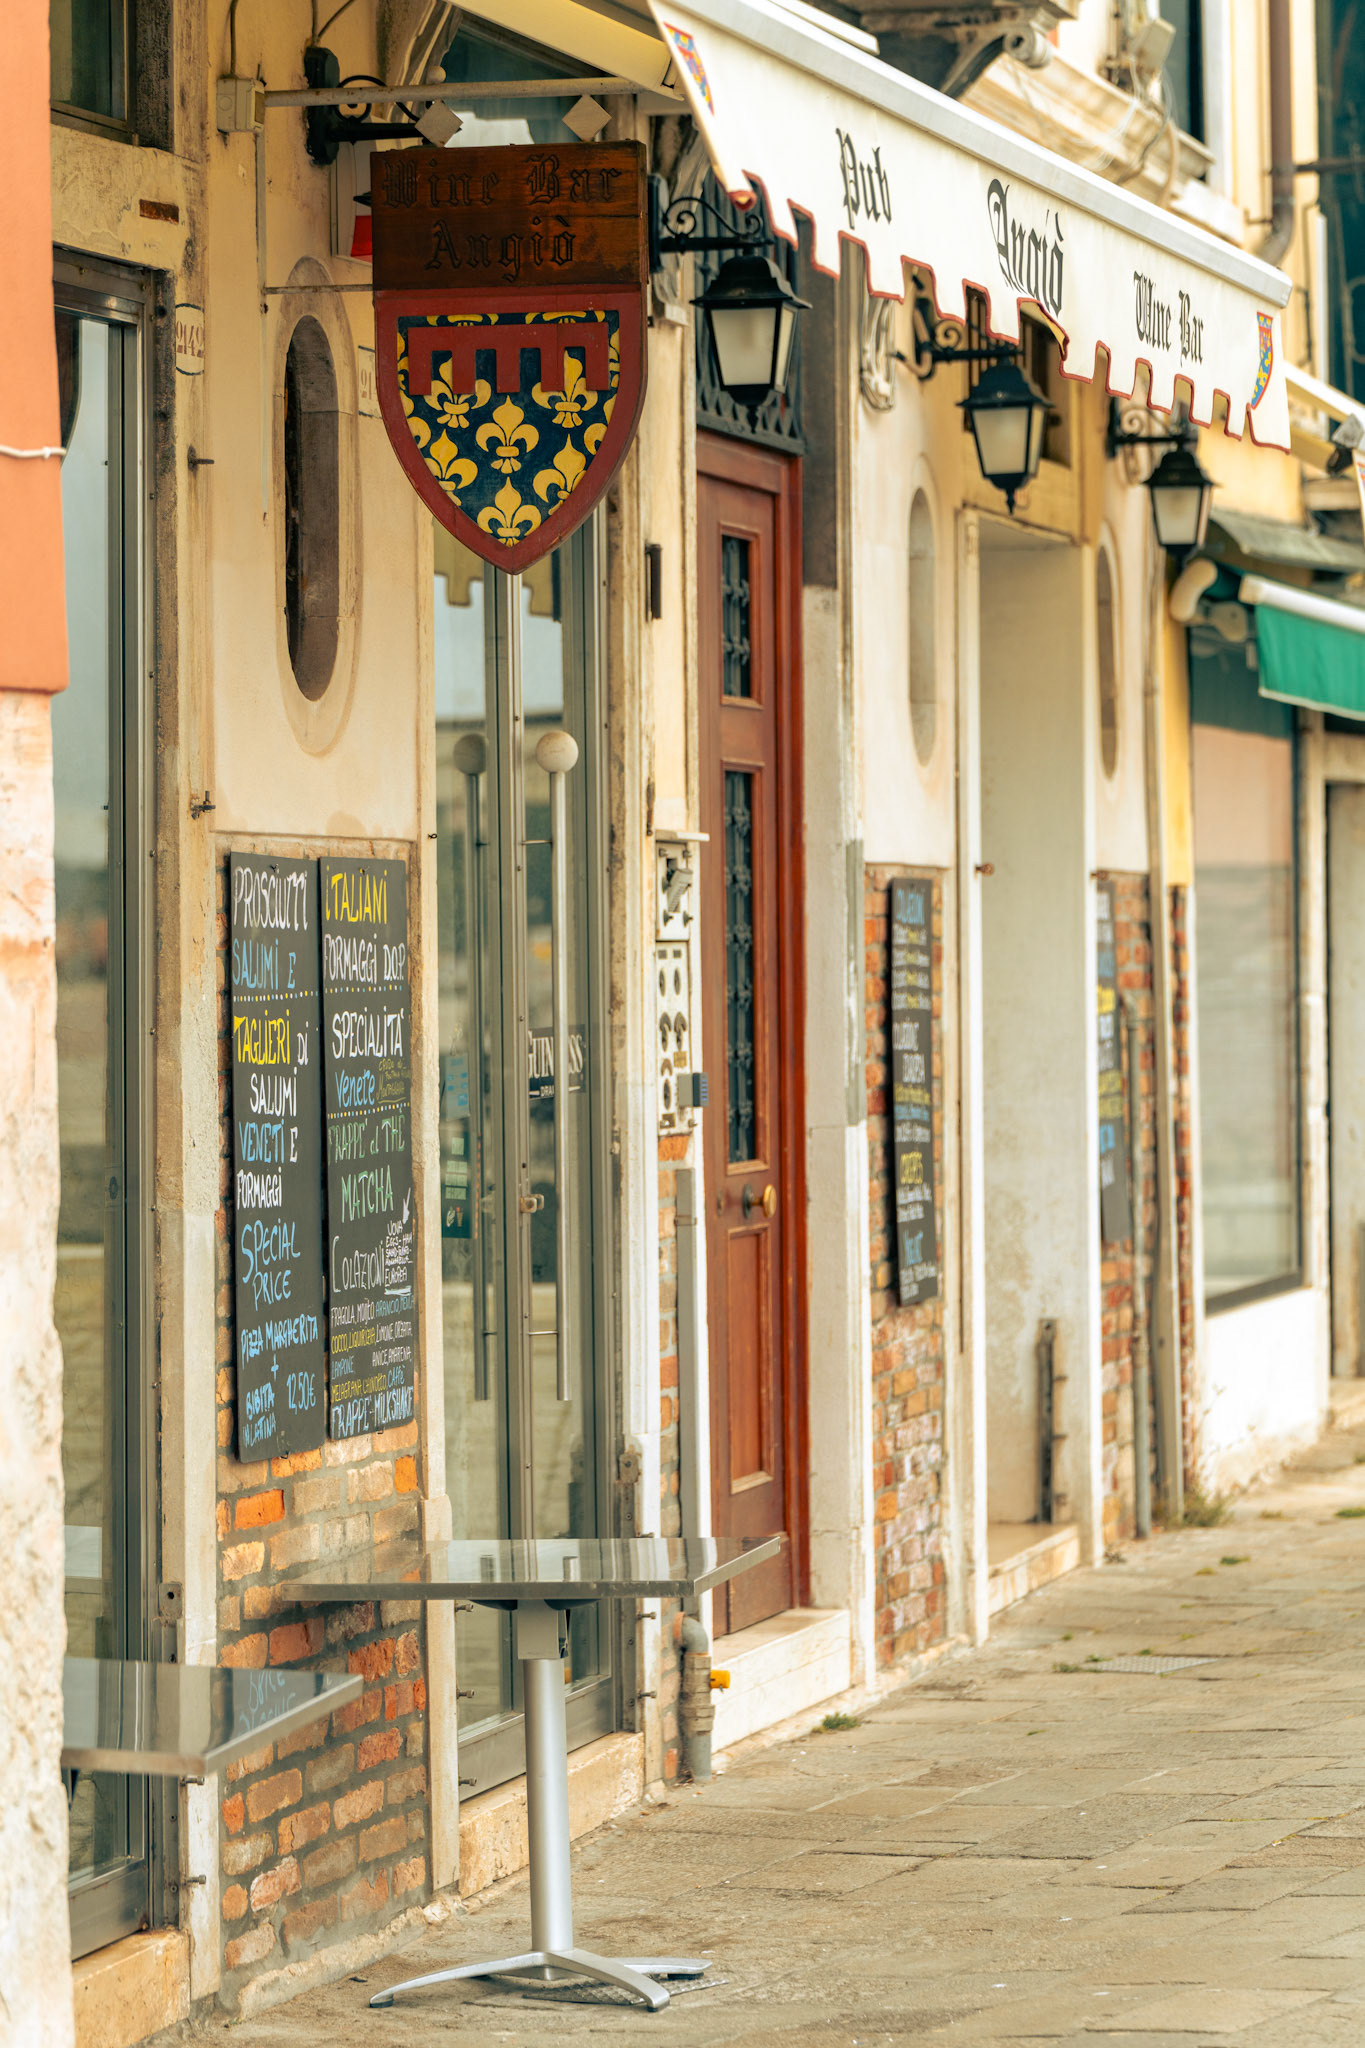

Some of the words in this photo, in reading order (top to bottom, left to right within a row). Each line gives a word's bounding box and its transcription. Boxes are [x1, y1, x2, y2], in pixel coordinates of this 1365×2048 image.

[382, 157, 500, 208] Wine
[525, 153, 622, 206] Bar
[836, 128, 892, 230] Pub
[425, 215, 576, 283] Angiò
[1133, 270, 1172, 351] Wine
[1179, 290, 1204, 367] Bar
[287, 952, 297, 989] E
[290, 1127, 298, 1162] E
[341, 1165, 393, 1224] MATCHA
[241, 1218, 300, 1284] SPECIAL
[253, 1269, 292, 1311] PRICE
[265, 1314, 318, 1350] MARGHERITA
